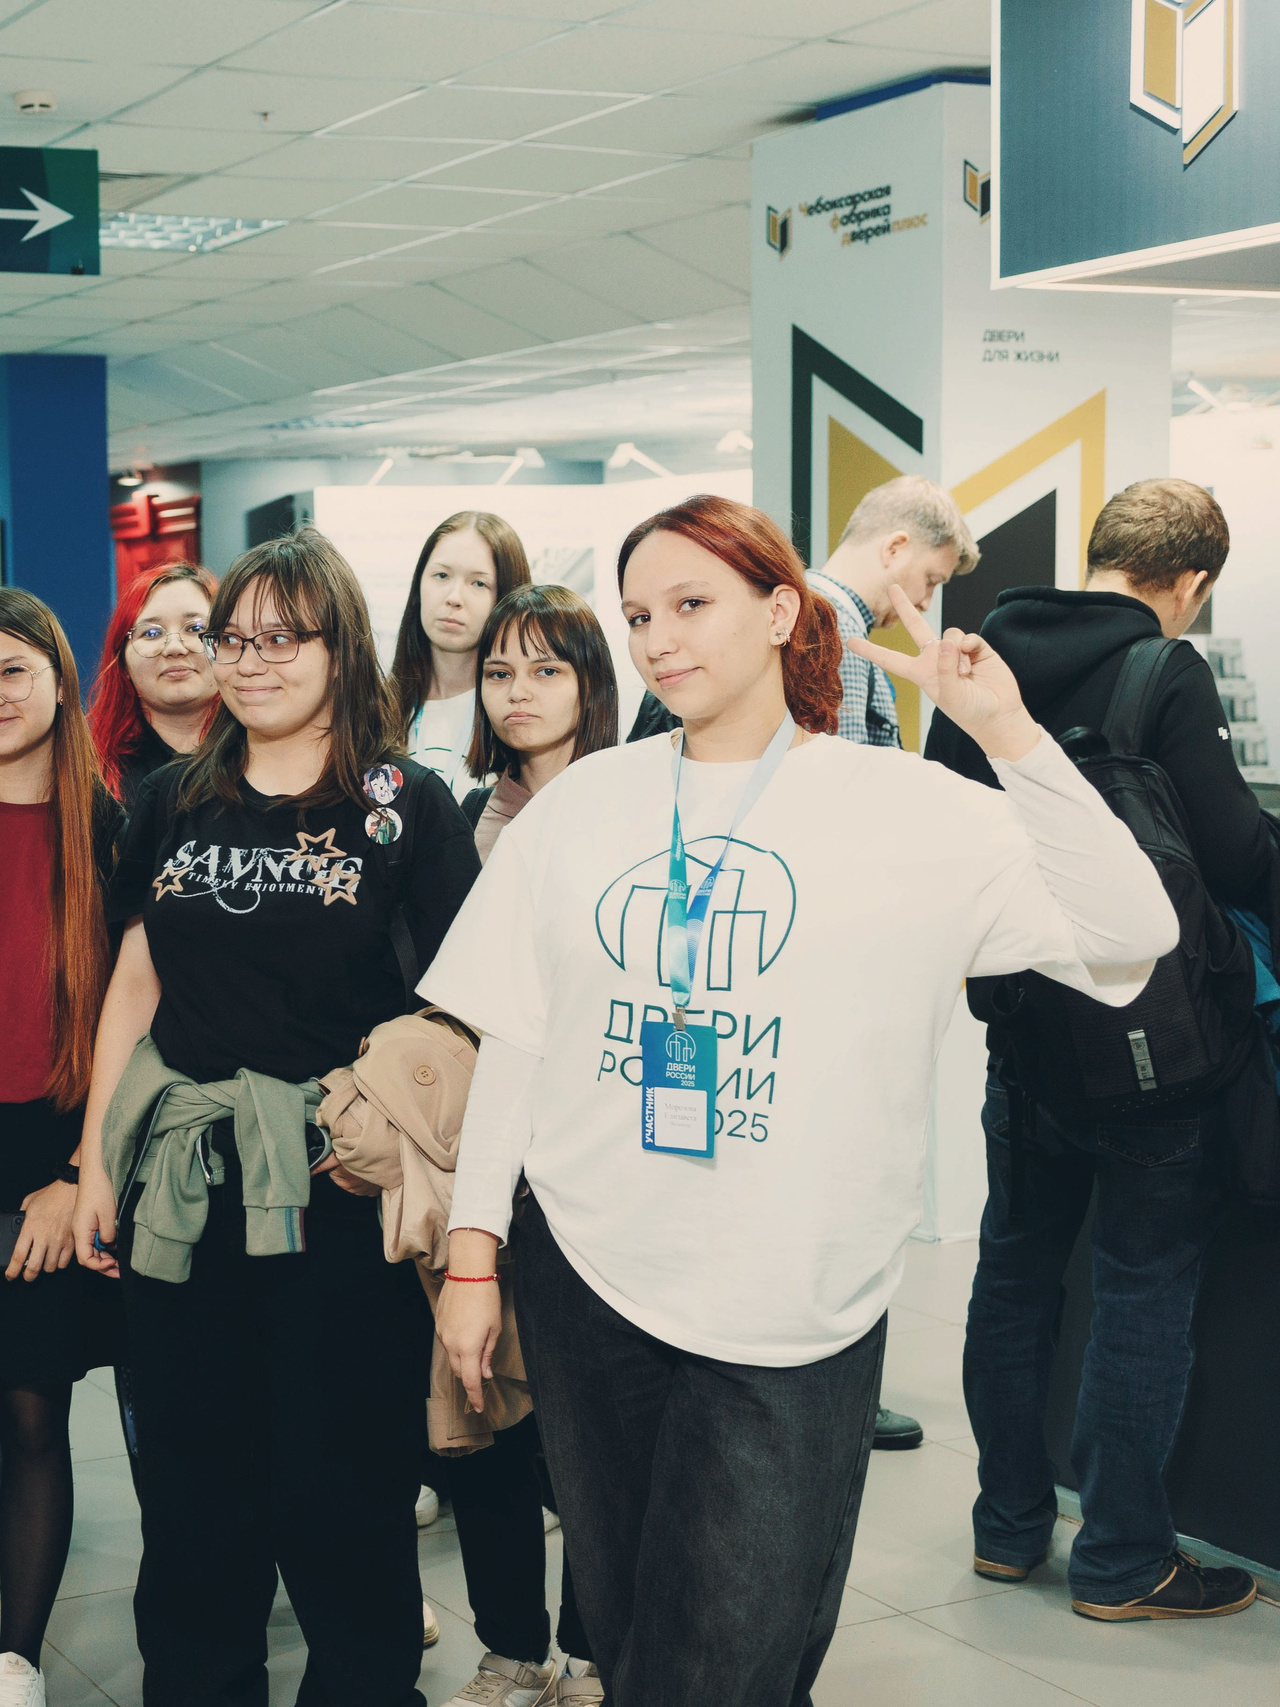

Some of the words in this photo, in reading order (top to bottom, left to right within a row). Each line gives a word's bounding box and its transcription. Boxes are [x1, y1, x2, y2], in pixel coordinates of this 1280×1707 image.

[798, 184, 892, 217] Чебоксарская
[982, 328, 1025, 342] ДВЕРИ
[982, 348, 1009, 362] ДЛЯ
[1013, 349, 1060, 363] ЖИЗНИ
[188, 871, 239, 890] TIMELY
[244, 882, 326, 897] ENJOYMENT
[666, 1062, 696, 1073] ДВЕРИ
[597, 1049, 776, 1105] РОИИ
[665, 1071, 696, 1081] РОССИИ
[680, 1079, 696, 1088] 2025
[645, 1086, 655, 1143] УЧАСТНИК
